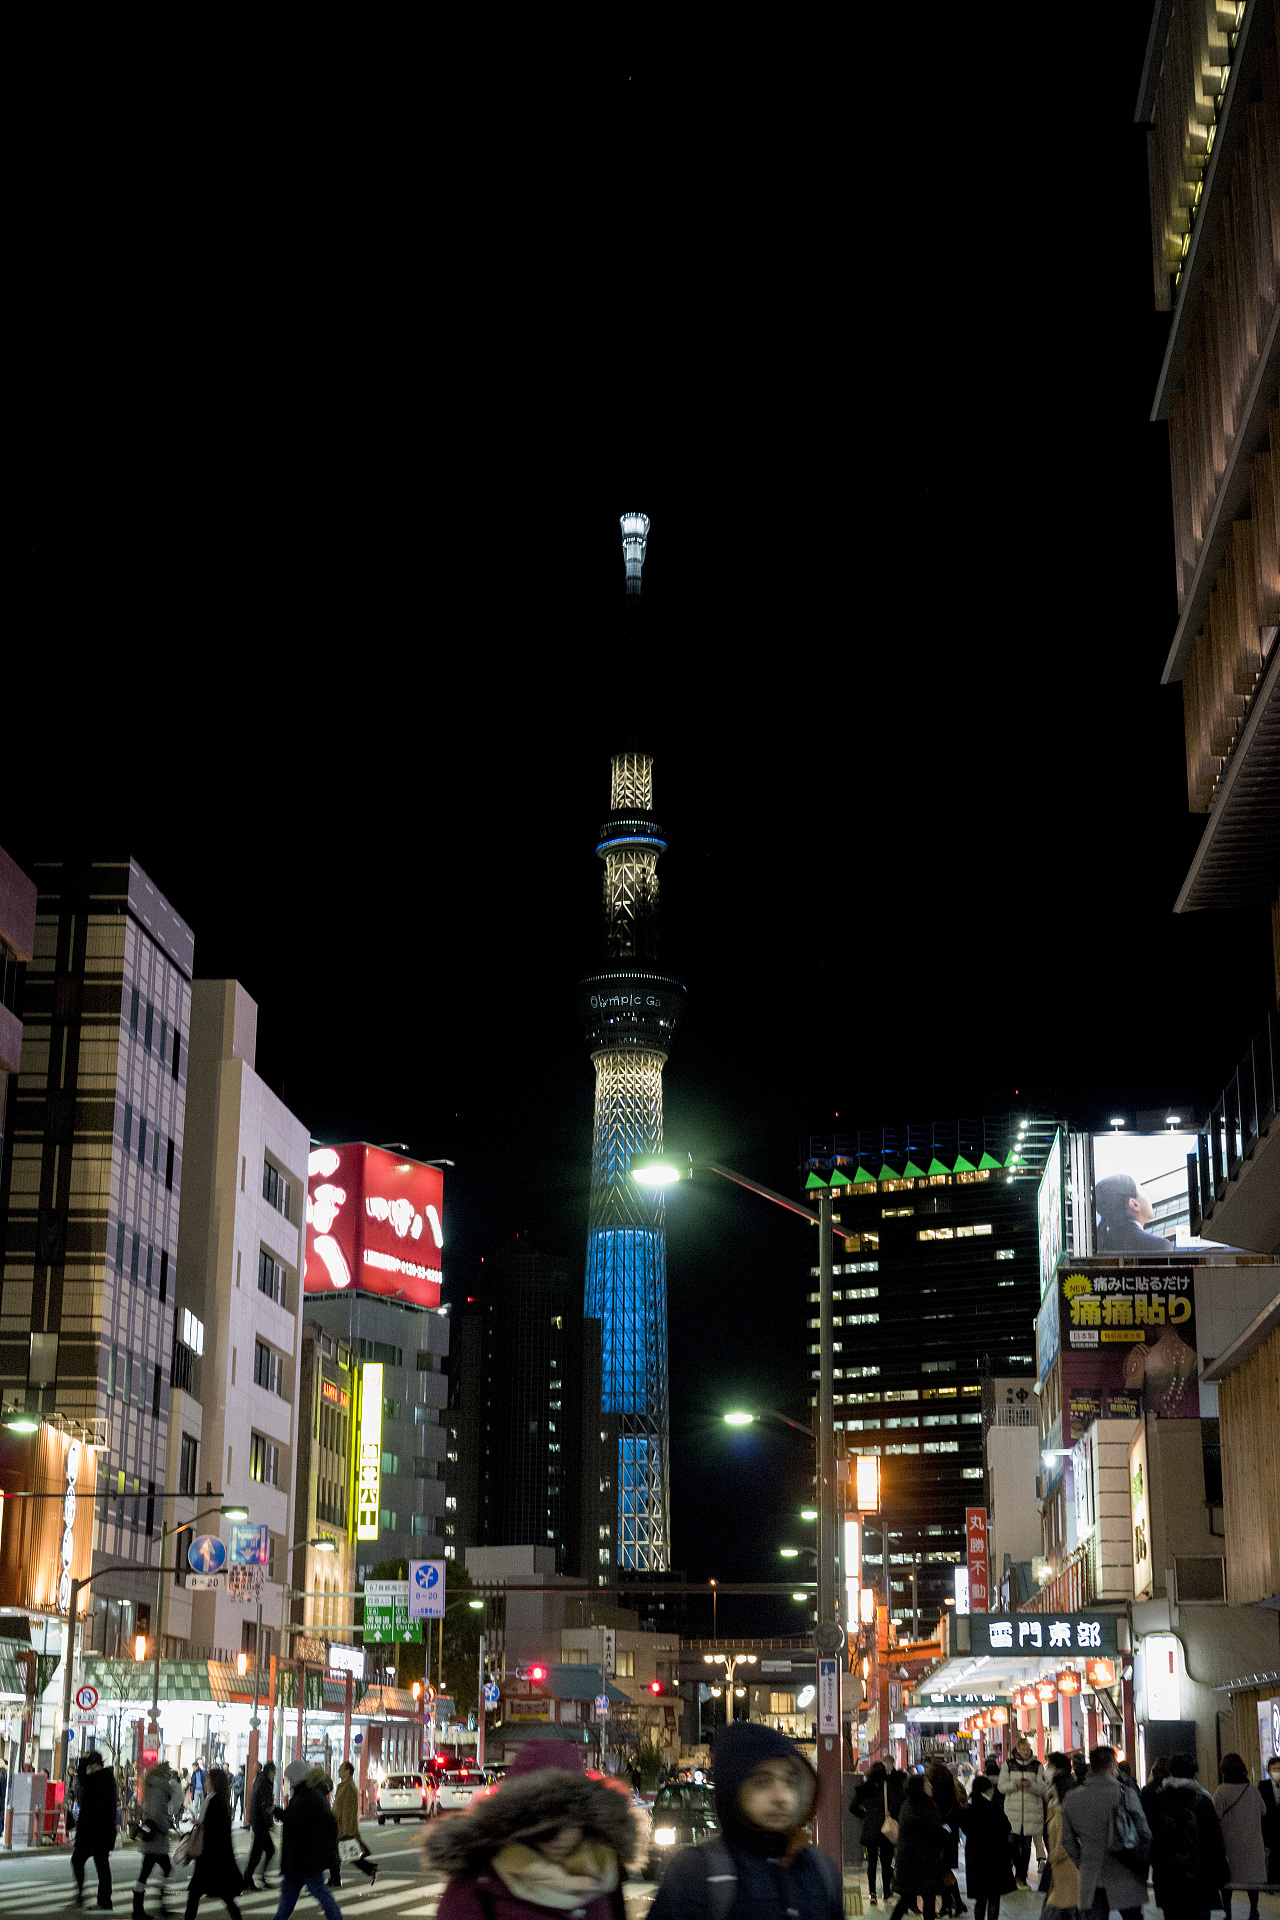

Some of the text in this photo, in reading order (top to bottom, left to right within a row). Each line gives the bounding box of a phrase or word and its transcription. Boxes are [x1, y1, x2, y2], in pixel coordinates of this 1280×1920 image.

[590, 994, 642, 1009] Olympic
[1069, 1284, 1087, 1293] NEW
[1093, 1275, 1191, 1292] 痛みに貼るだけ
[1069, 1293, 1192, 1326] 痛痛貼り
[1073, 1331, 1096, 1340] 日本製
[988, 1620, 1102, 1648] 雷門東部
